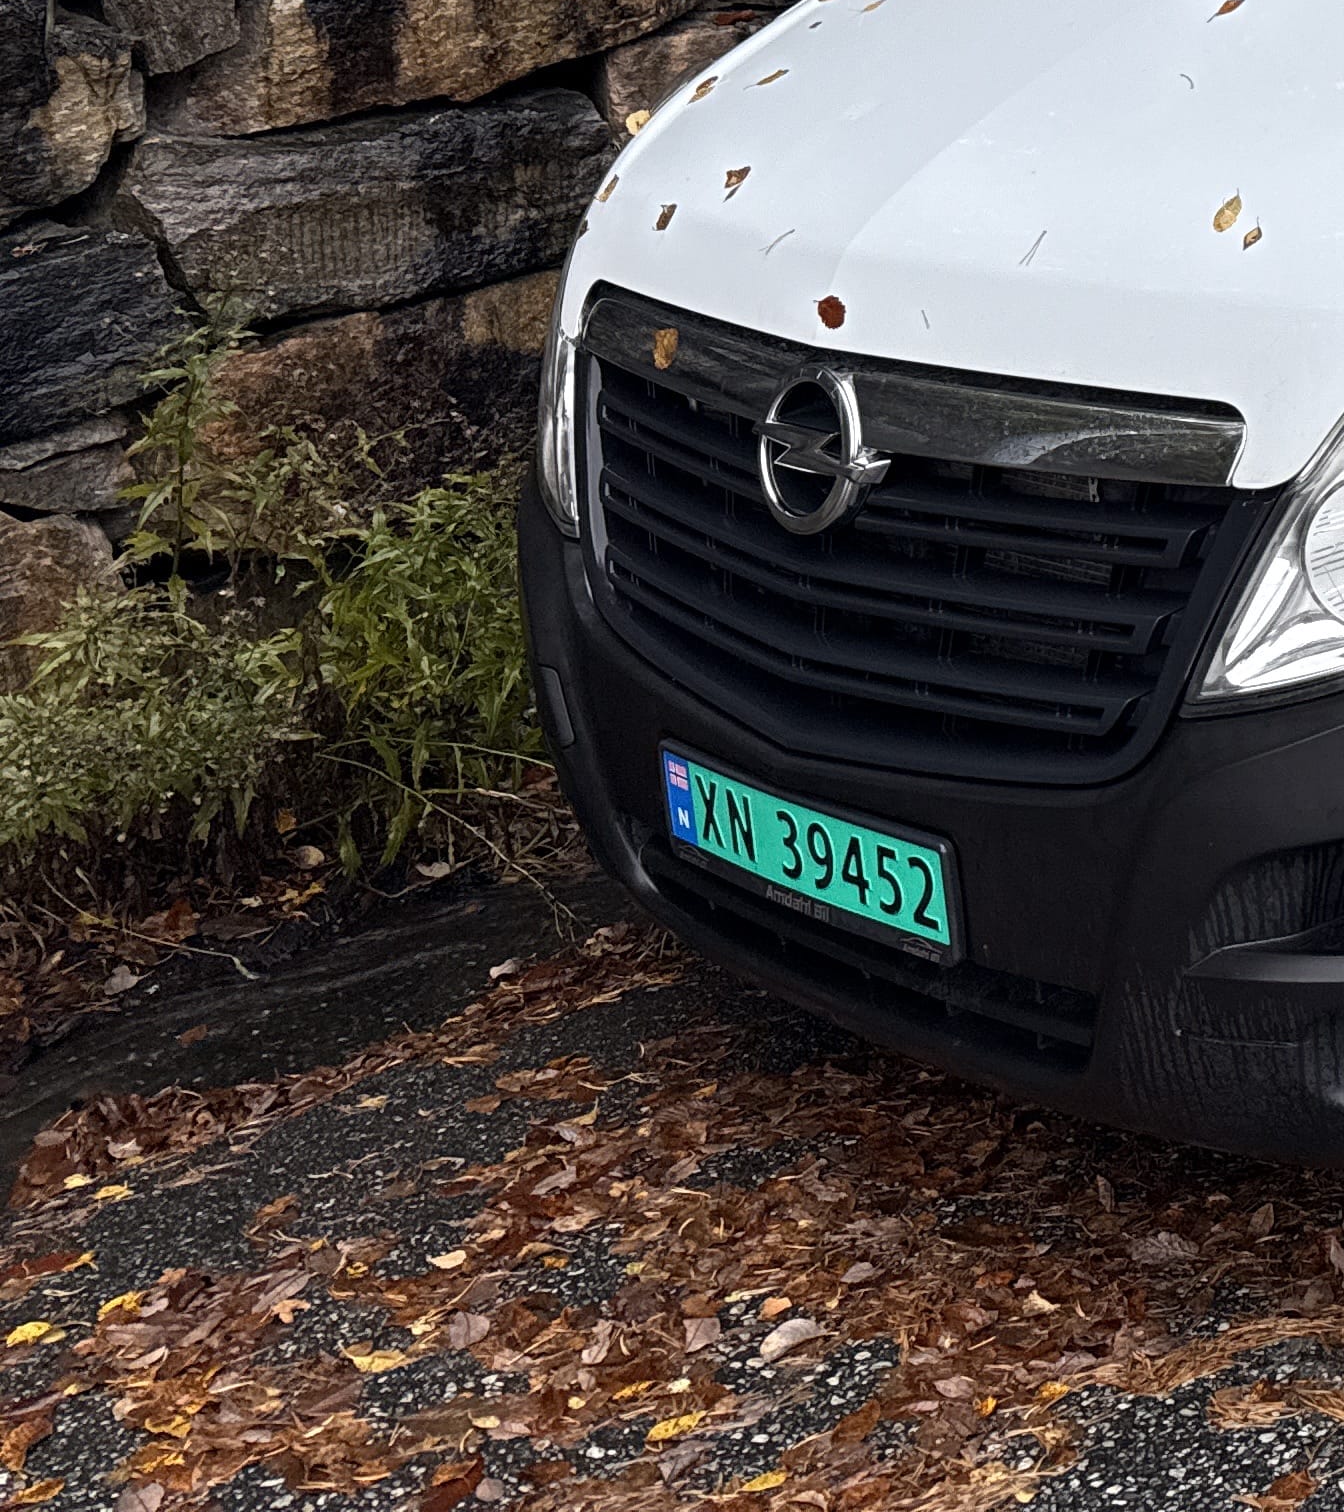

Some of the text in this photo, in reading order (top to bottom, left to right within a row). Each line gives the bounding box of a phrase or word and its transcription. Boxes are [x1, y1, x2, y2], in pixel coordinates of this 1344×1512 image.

[677, 806, 690, 829] N
[695, 773, 942, 932] XN 39452
